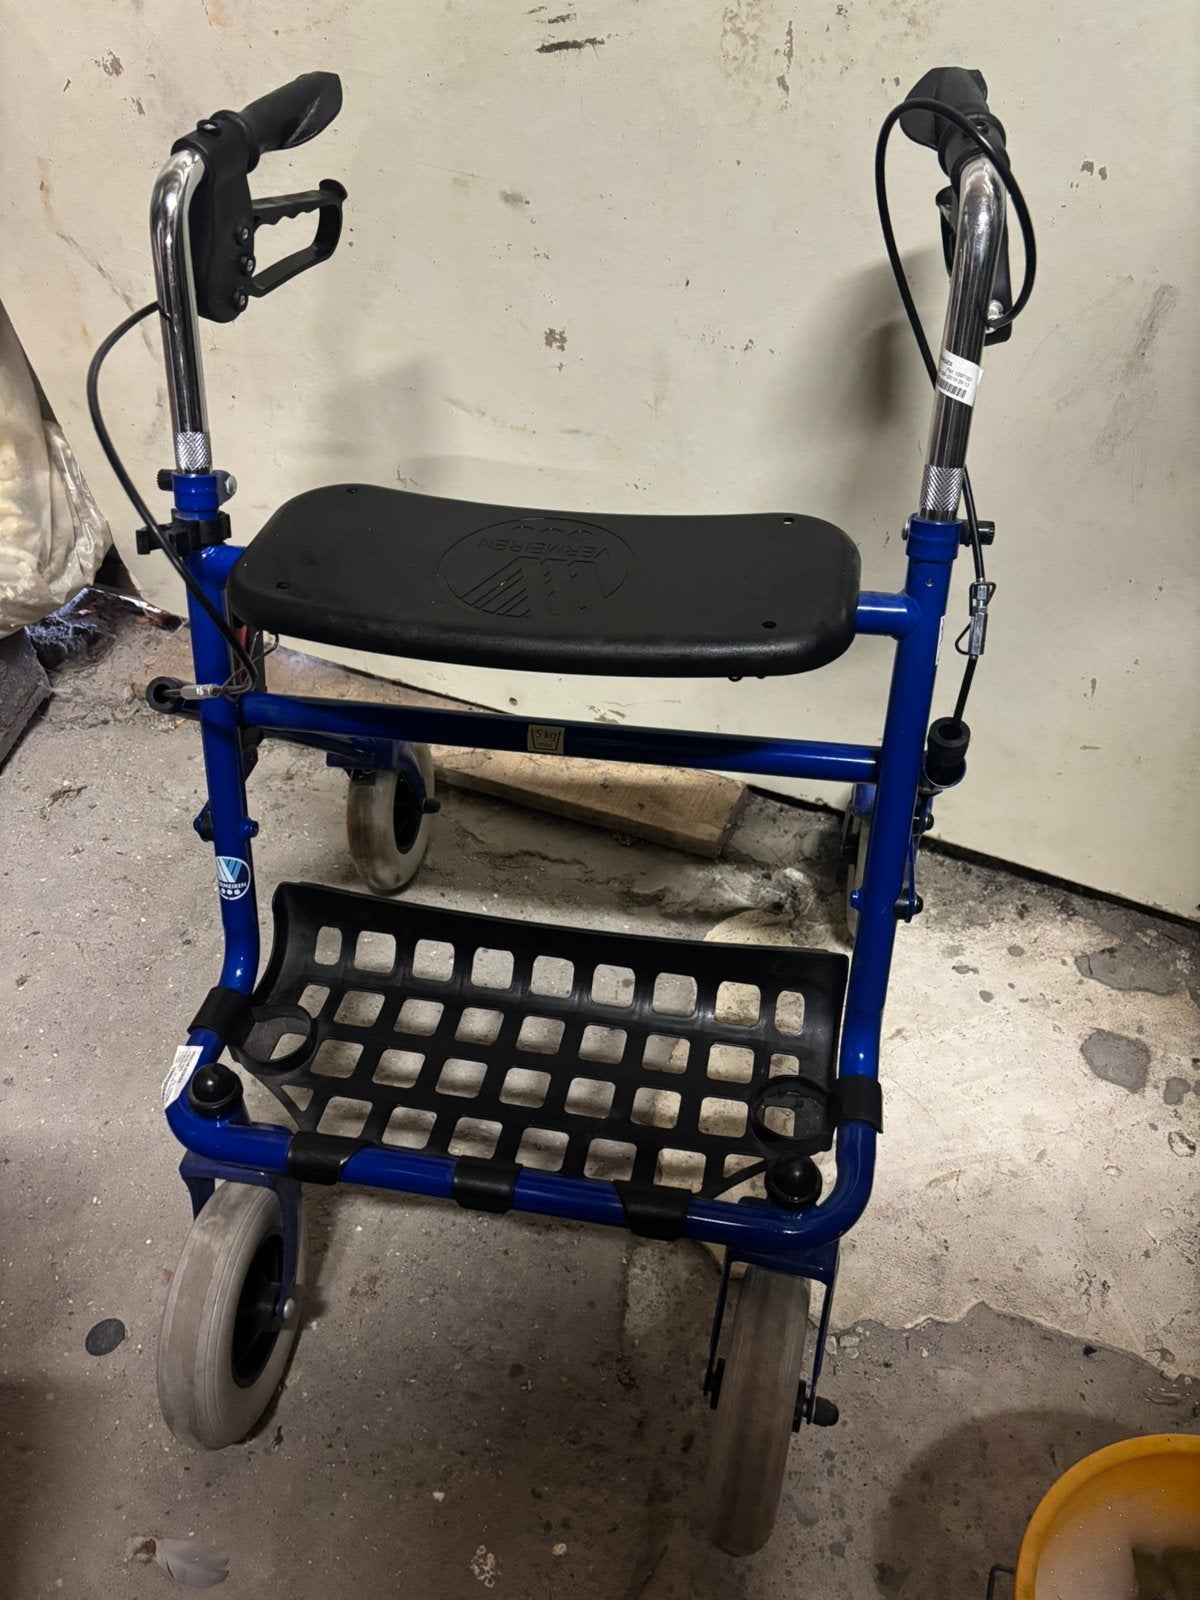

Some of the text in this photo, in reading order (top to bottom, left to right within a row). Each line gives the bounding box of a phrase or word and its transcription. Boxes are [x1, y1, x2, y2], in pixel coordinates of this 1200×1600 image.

[477, 537, 610, 559] VERMEIREN
[535, 728, 557, 742] 5 kg
